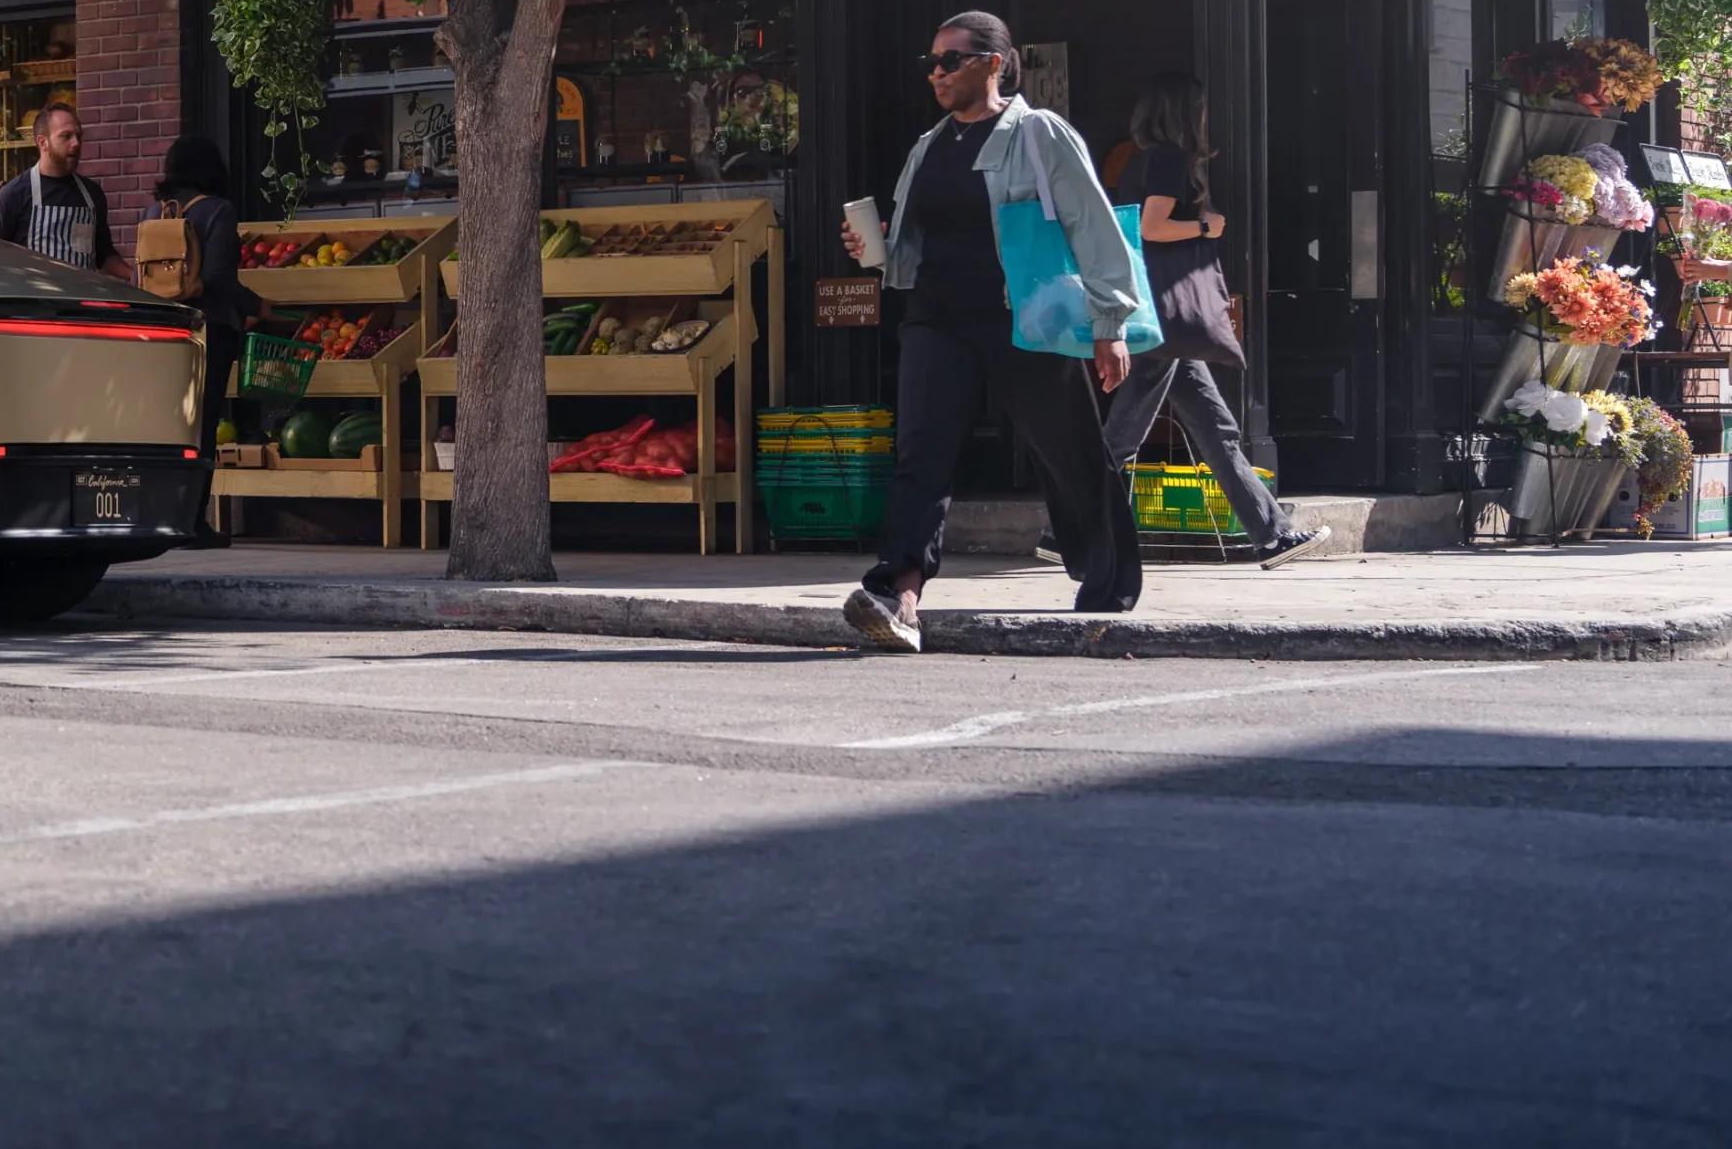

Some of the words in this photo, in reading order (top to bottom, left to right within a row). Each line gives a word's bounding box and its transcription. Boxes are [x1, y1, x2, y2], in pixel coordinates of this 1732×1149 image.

[819, 286, 834, 296] USE
[836, 286, 843, 295] A
[845, 285, 874, 295] BASKET
[819, 306, 836, 316] EASY
[837, 305, 874, 315] SHOPPING
[88, 474, 128, 491] California
[96, 492, 121, 518] 001
